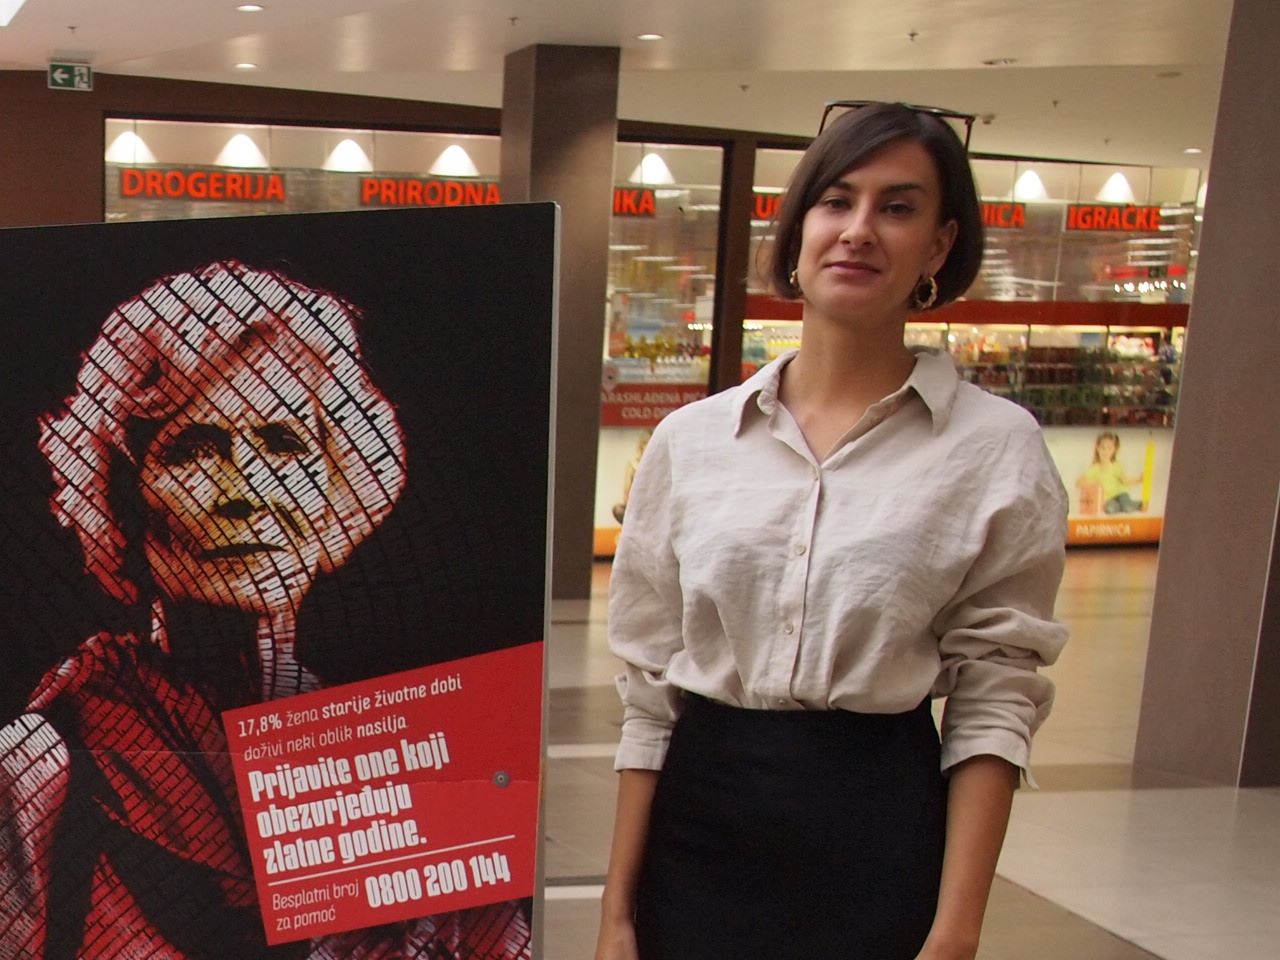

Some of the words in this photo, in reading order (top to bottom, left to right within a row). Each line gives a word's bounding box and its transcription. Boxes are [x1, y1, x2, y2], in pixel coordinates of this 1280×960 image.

[122, 169, 286, 201] DROGERIJA
[362, 179, 502, 205] PRIRODNA
[613, 190, 656, 215] IKA
[1069, 203, 1161, 231] IGRAČKE
[238, 713, 282, 738] 17,8%
[286, 706, 319, 727] žena
[321, 695, 371, 718] starije
[375, 682, 427, 708] životne
[430, 673, 463, 697] dobi
[244, 740, 284, 762] doživi
[286, 730, 316, 753] neki
[319, 726, 353, 748] oblik
[356, 715, 408, 739] nasilja
[248, 756, 352, 803] Prijavite
[354, 747, 400, 781] one
[400, 731, 450, 772] koji
[256, 780, 413, 839] obezvrjeđuju
[263, 834, 336, 875] zlatne
[337, 818, 428, 864] godine.
[272, 884, 331, 911] Besplatni
[332, 879, 360, 899] broj
[364, 867, 423, 909] 0800
[423, 858, 468, 897] 200
[469, 852, 511, 889] 144
[276, 915, 292, 931] za
[293, 905, 337, 929] pomoć
